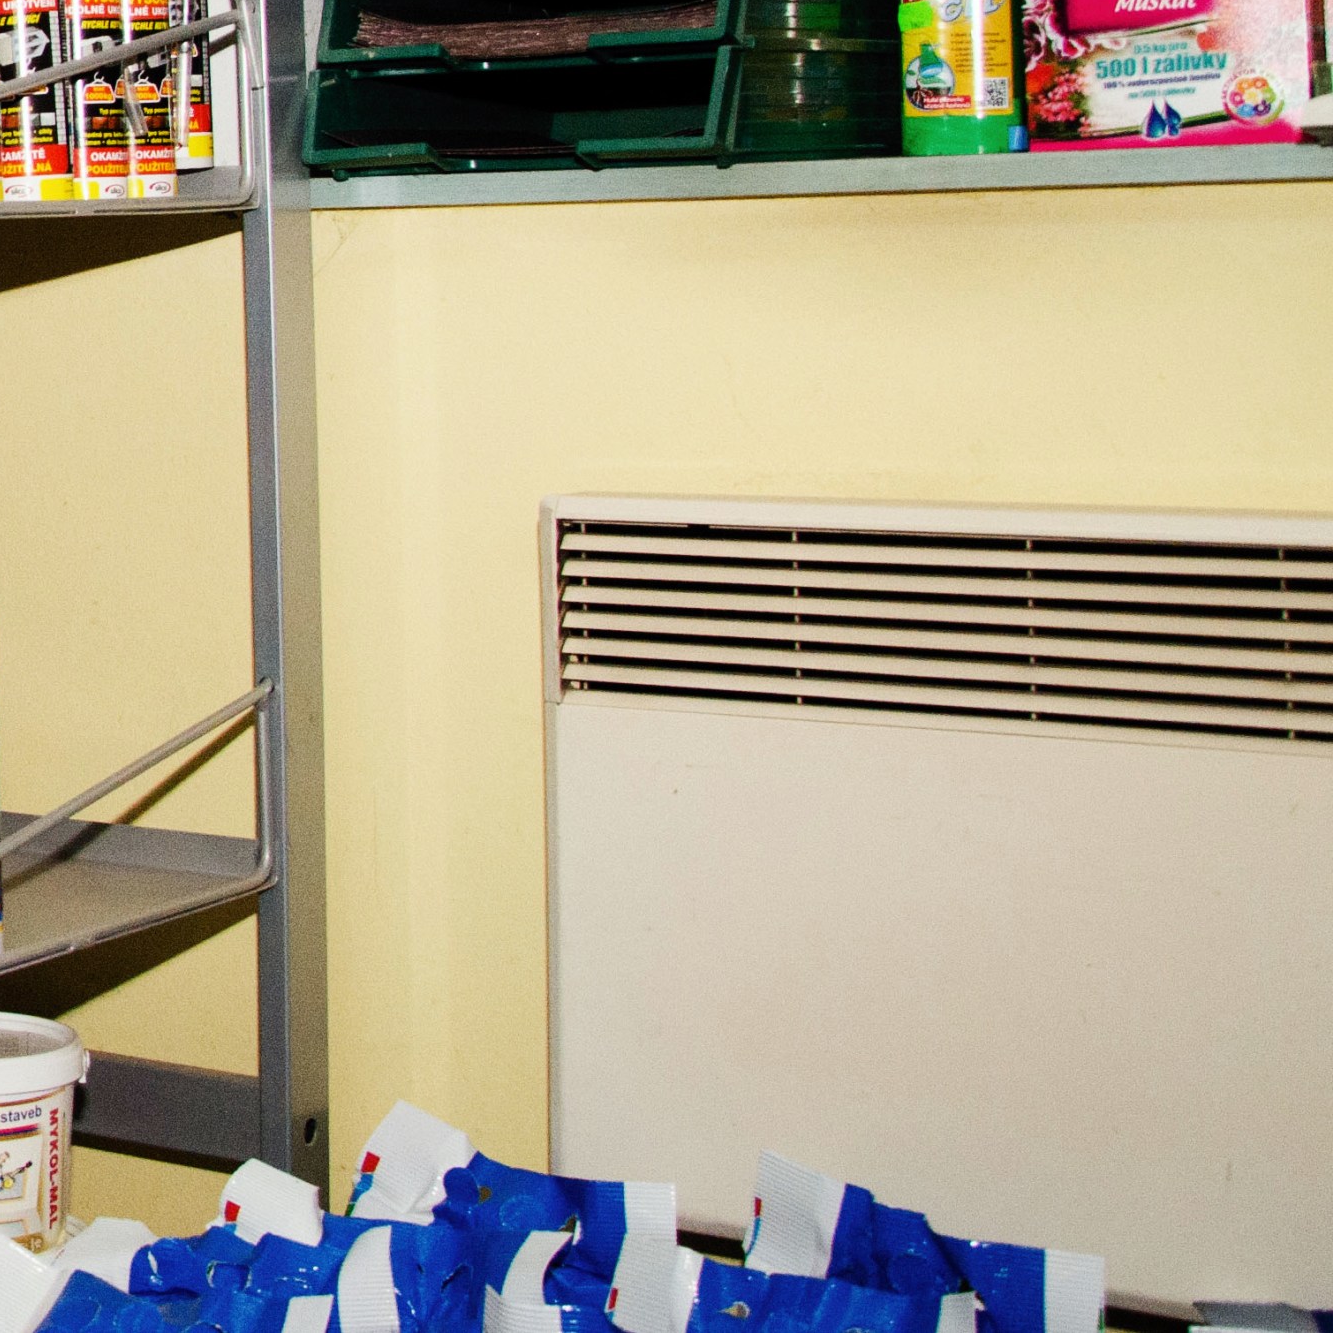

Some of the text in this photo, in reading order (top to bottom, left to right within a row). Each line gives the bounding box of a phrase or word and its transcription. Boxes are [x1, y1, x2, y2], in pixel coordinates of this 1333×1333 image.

[1095, 56, 1137, 80] 500
[1152, 49, 1230, 77] zálivky
[0, 1104, 44, 1125] staveb
[47, 1107, 61, 1231] MYKOL-MAL
